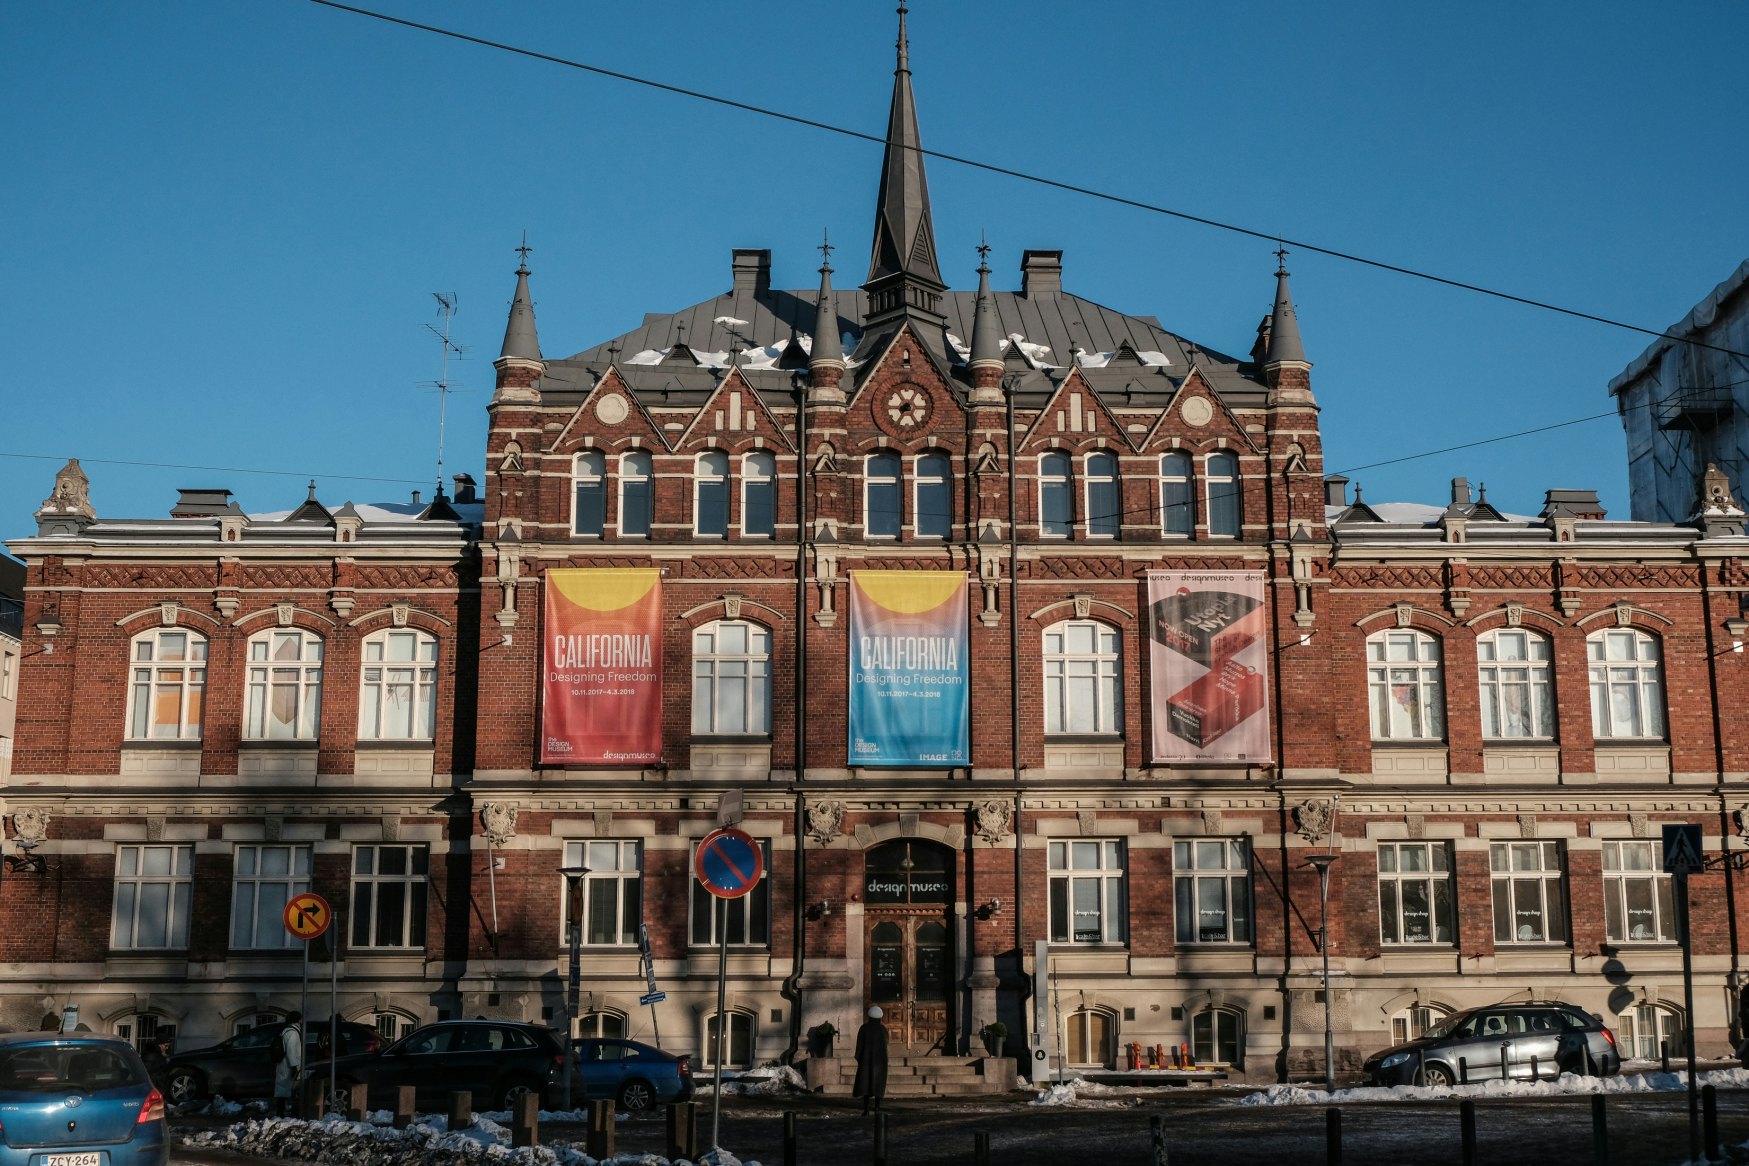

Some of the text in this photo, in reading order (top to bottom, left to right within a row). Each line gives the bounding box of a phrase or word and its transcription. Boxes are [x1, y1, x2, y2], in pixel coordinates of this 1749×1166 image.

[1181, 573, 1234, 584] designmuseo
[1197, 612, 1232, 632] Nyt
[1159, 620, 1199, 645] NOW OPEN
[1166, 632, 1190, 650] 2017
[555, 634, 652, 668] CALIFORNIA
[861, 636, 957, 670] CALIFORNIA
[550, 671, 657, 683] Designing Freedom
[856, 673, 962, 686] Designing Freedom
[603, 750, 655, 761] designmuseo
